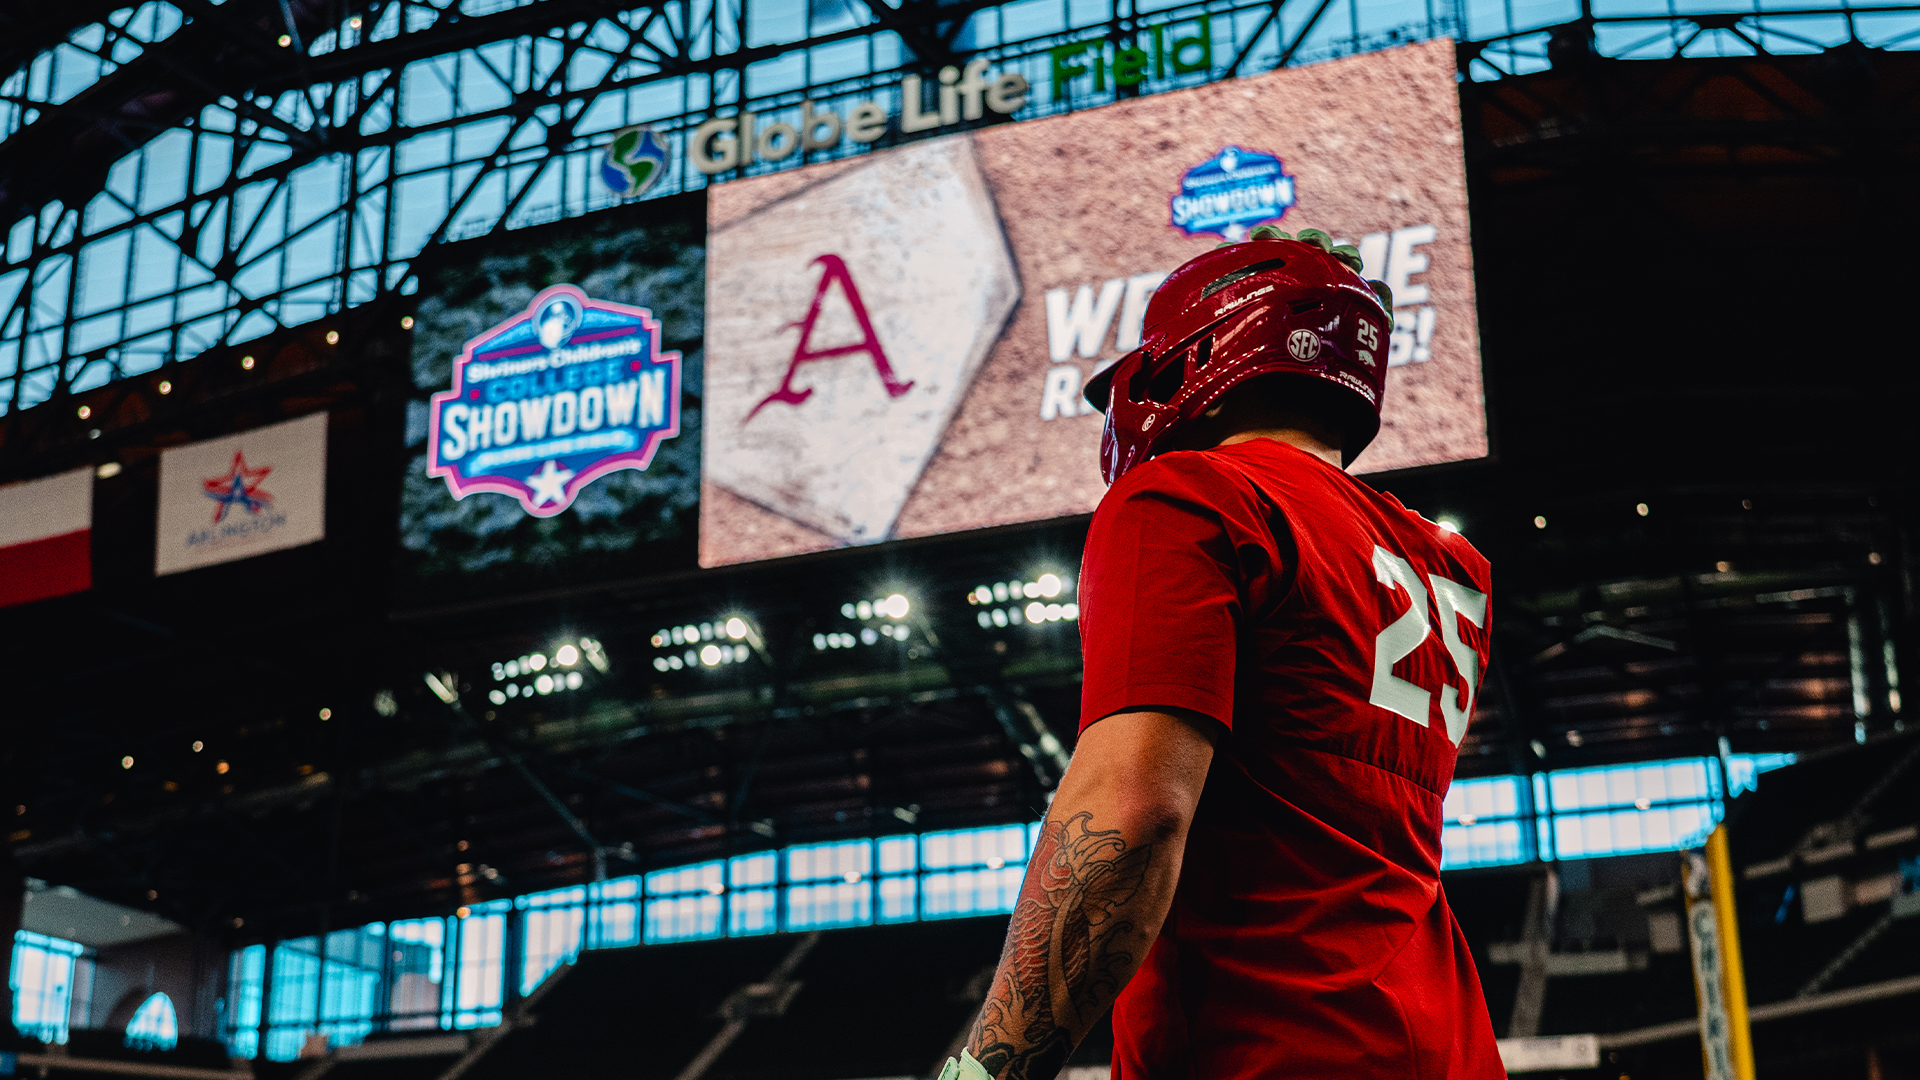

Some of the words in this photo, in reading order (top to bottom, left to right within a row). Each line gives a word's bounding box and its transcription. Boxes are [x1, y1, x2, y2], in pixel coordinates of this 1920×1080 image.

[691, 98, 888, 174] Globe
[901, 60, 1028, 133] Life
[1050, 13, 1212, 100] Field
[738, 253, 915, 428] A
[1289, 330, 1319, 360] SEC
[1356, 317, 1379, 352] 25
[466, 354, 549, 385] Shriners
[487, 358, 625, 402] COLLEGE
[441, 367, 666, 461] SHOWDOWN
[1368, 544, 1487, 749] 25
